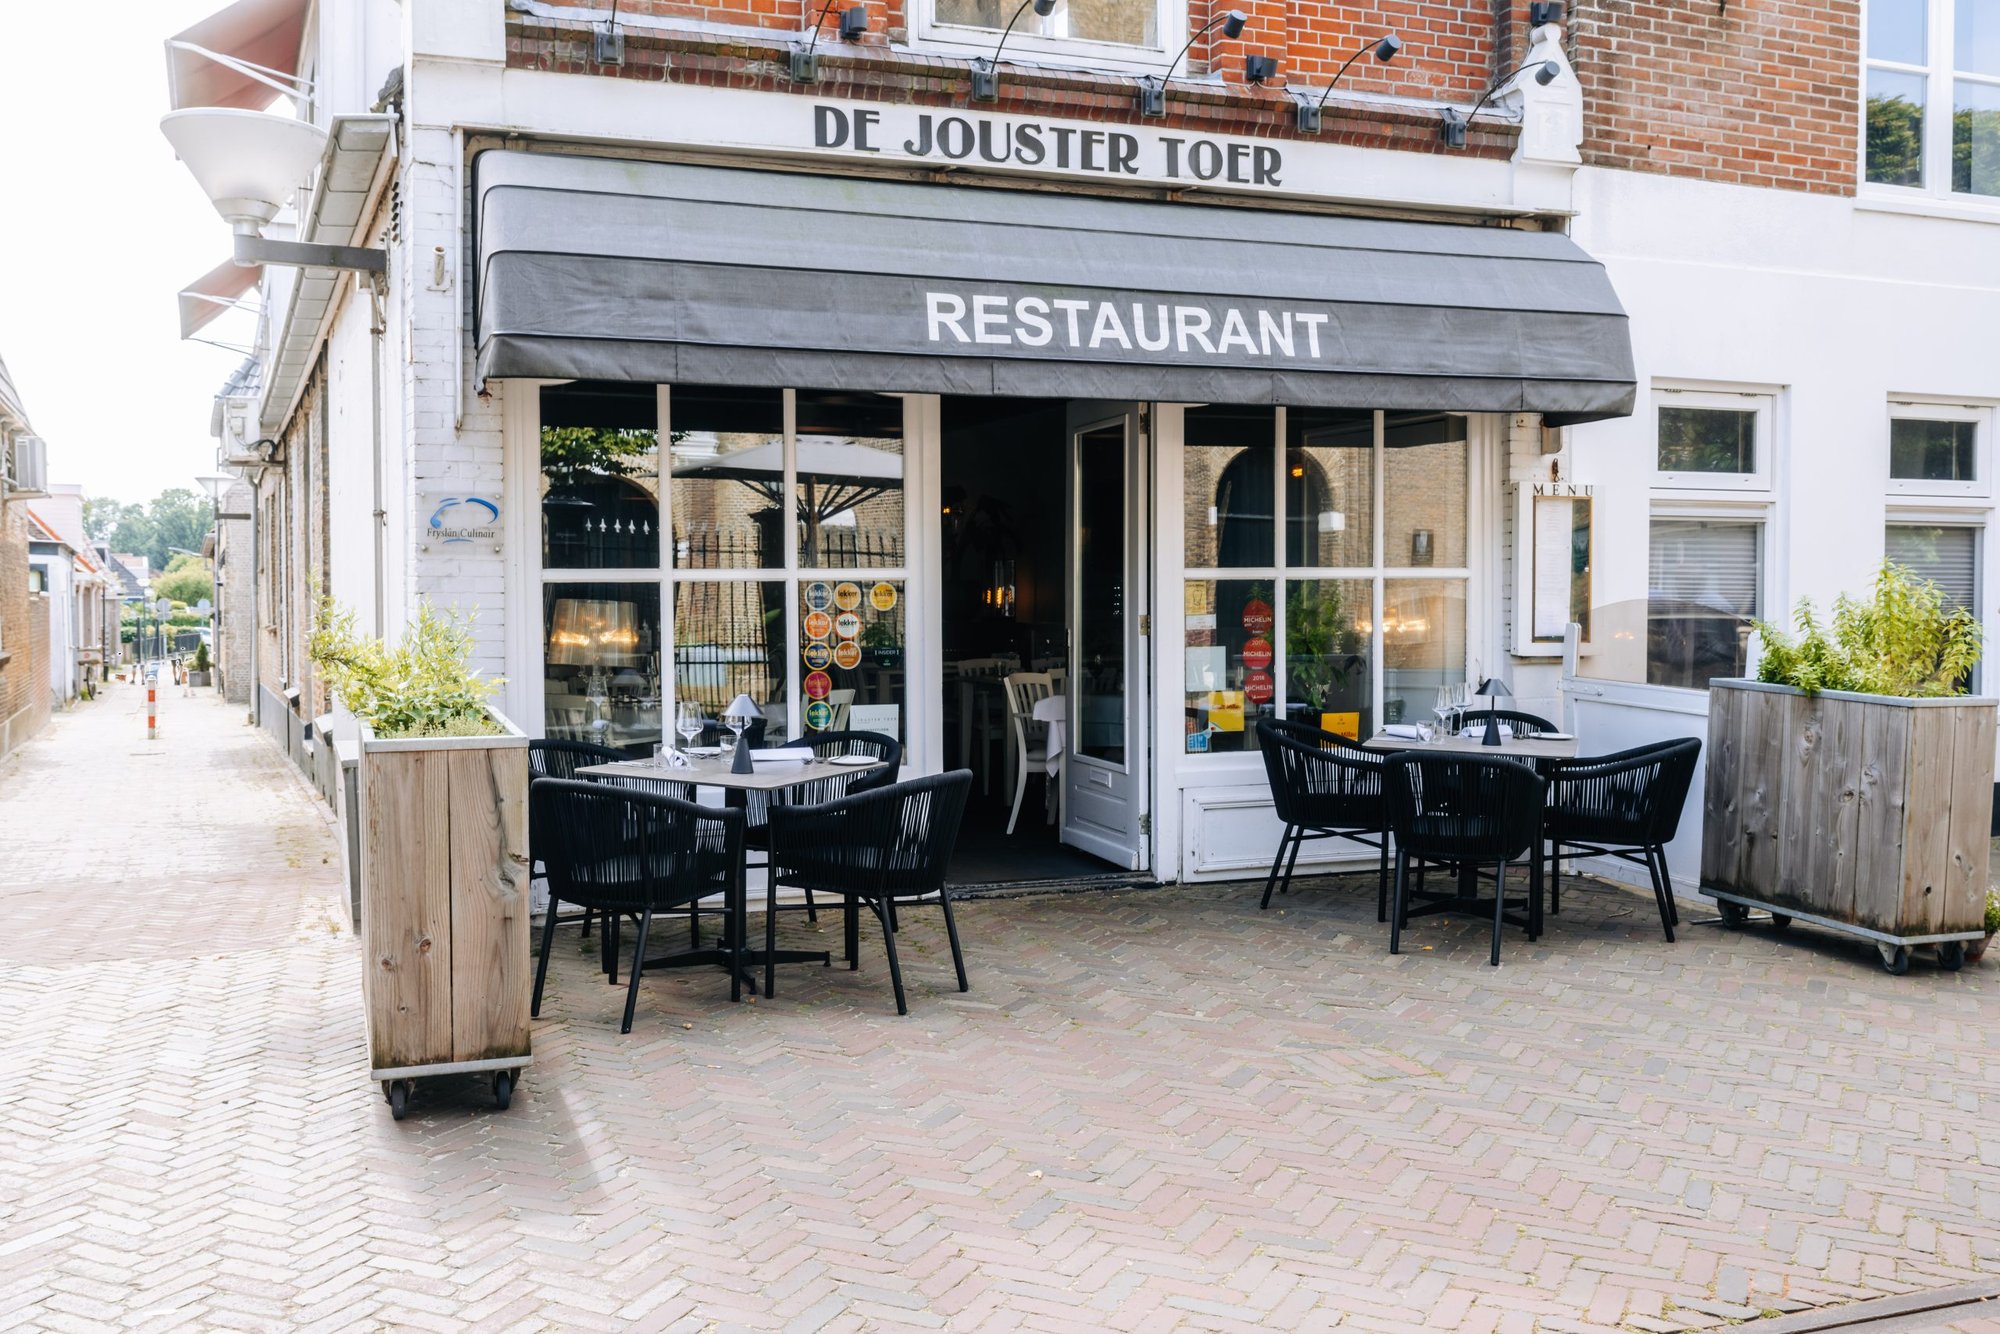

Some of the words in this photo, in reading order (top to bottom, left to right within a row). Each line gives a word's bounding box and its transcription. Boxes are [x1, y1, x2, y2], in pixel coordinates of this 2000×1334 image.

[813, 105, 881, 152] DE
[903, 113, 1139, 175] JOUSTER
[1158, 136, 1283, 187] TOER
[926, 291, 1328, 358] RESTAURANT
[1533, 483, 1593, 496] MENU
[460, 528, 495, 538] Culinair
